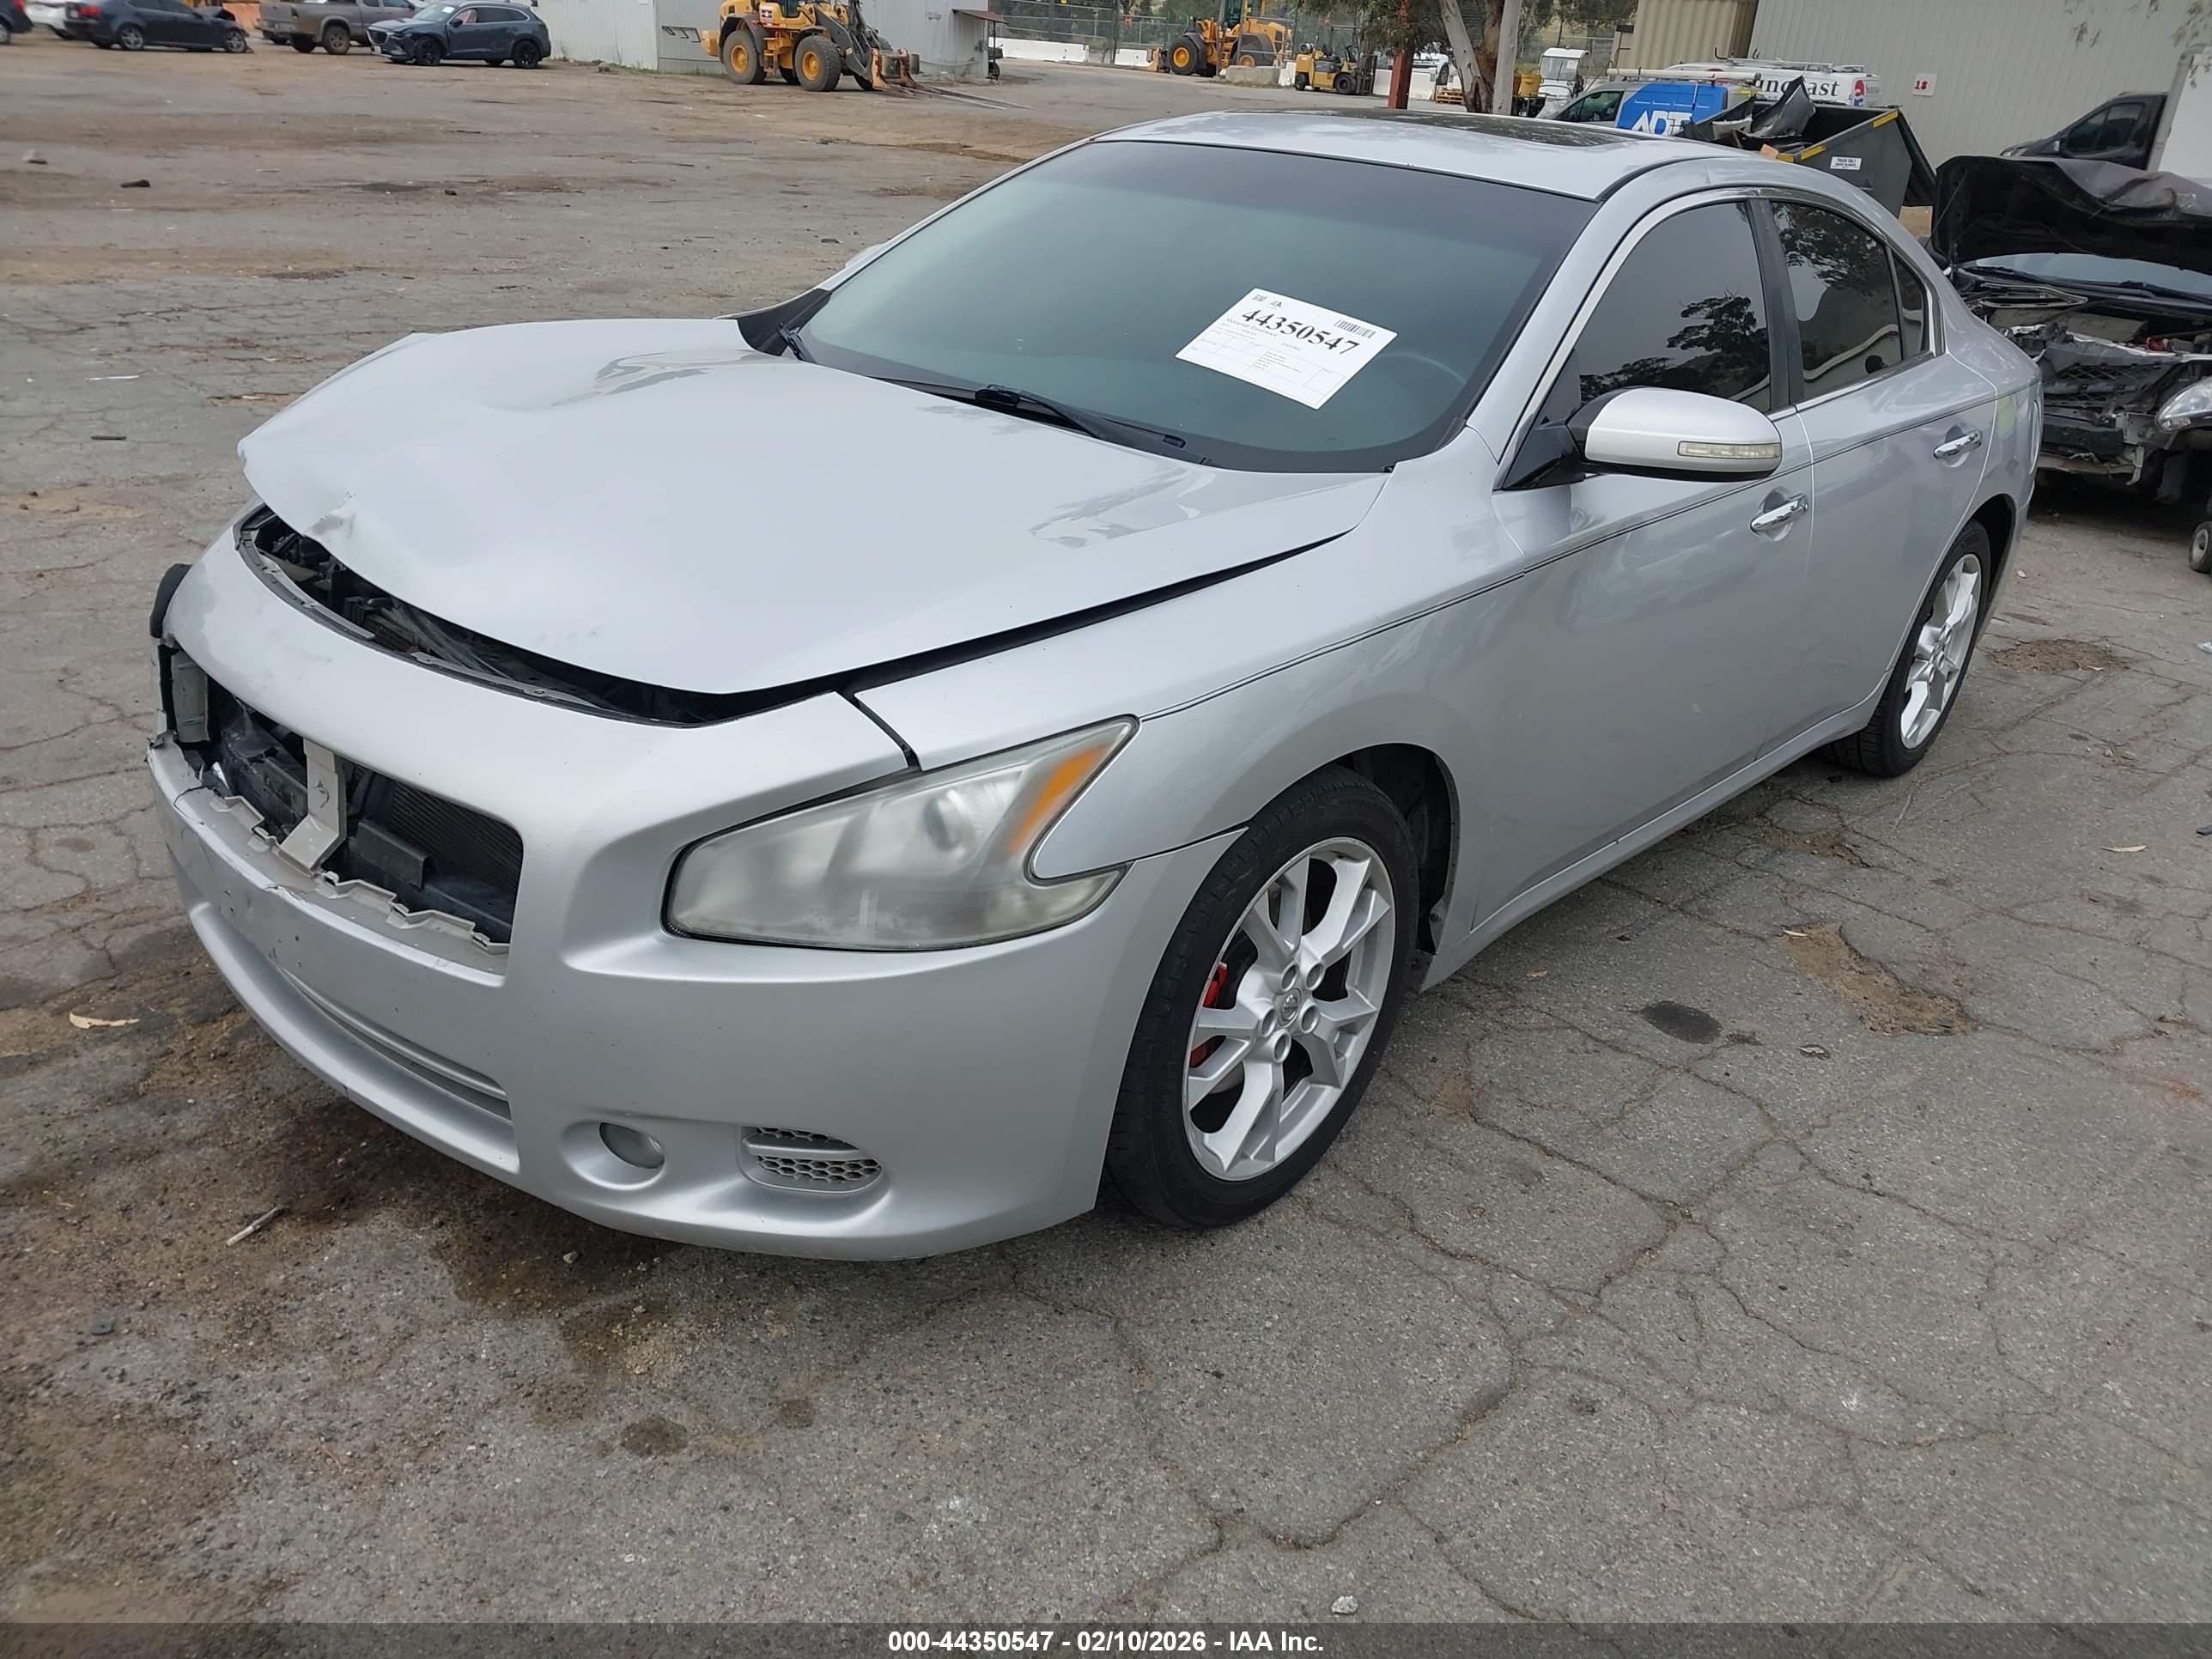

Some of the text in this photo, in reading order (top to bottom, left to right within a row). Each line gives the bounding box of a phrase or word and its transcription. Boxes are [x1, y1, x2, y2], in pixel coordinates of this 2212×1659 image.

[1914, 80, 1929, 90] 18
[1632, 110, 1693, 137] ADT
[1242, 309, 1361, 355] 44350547
